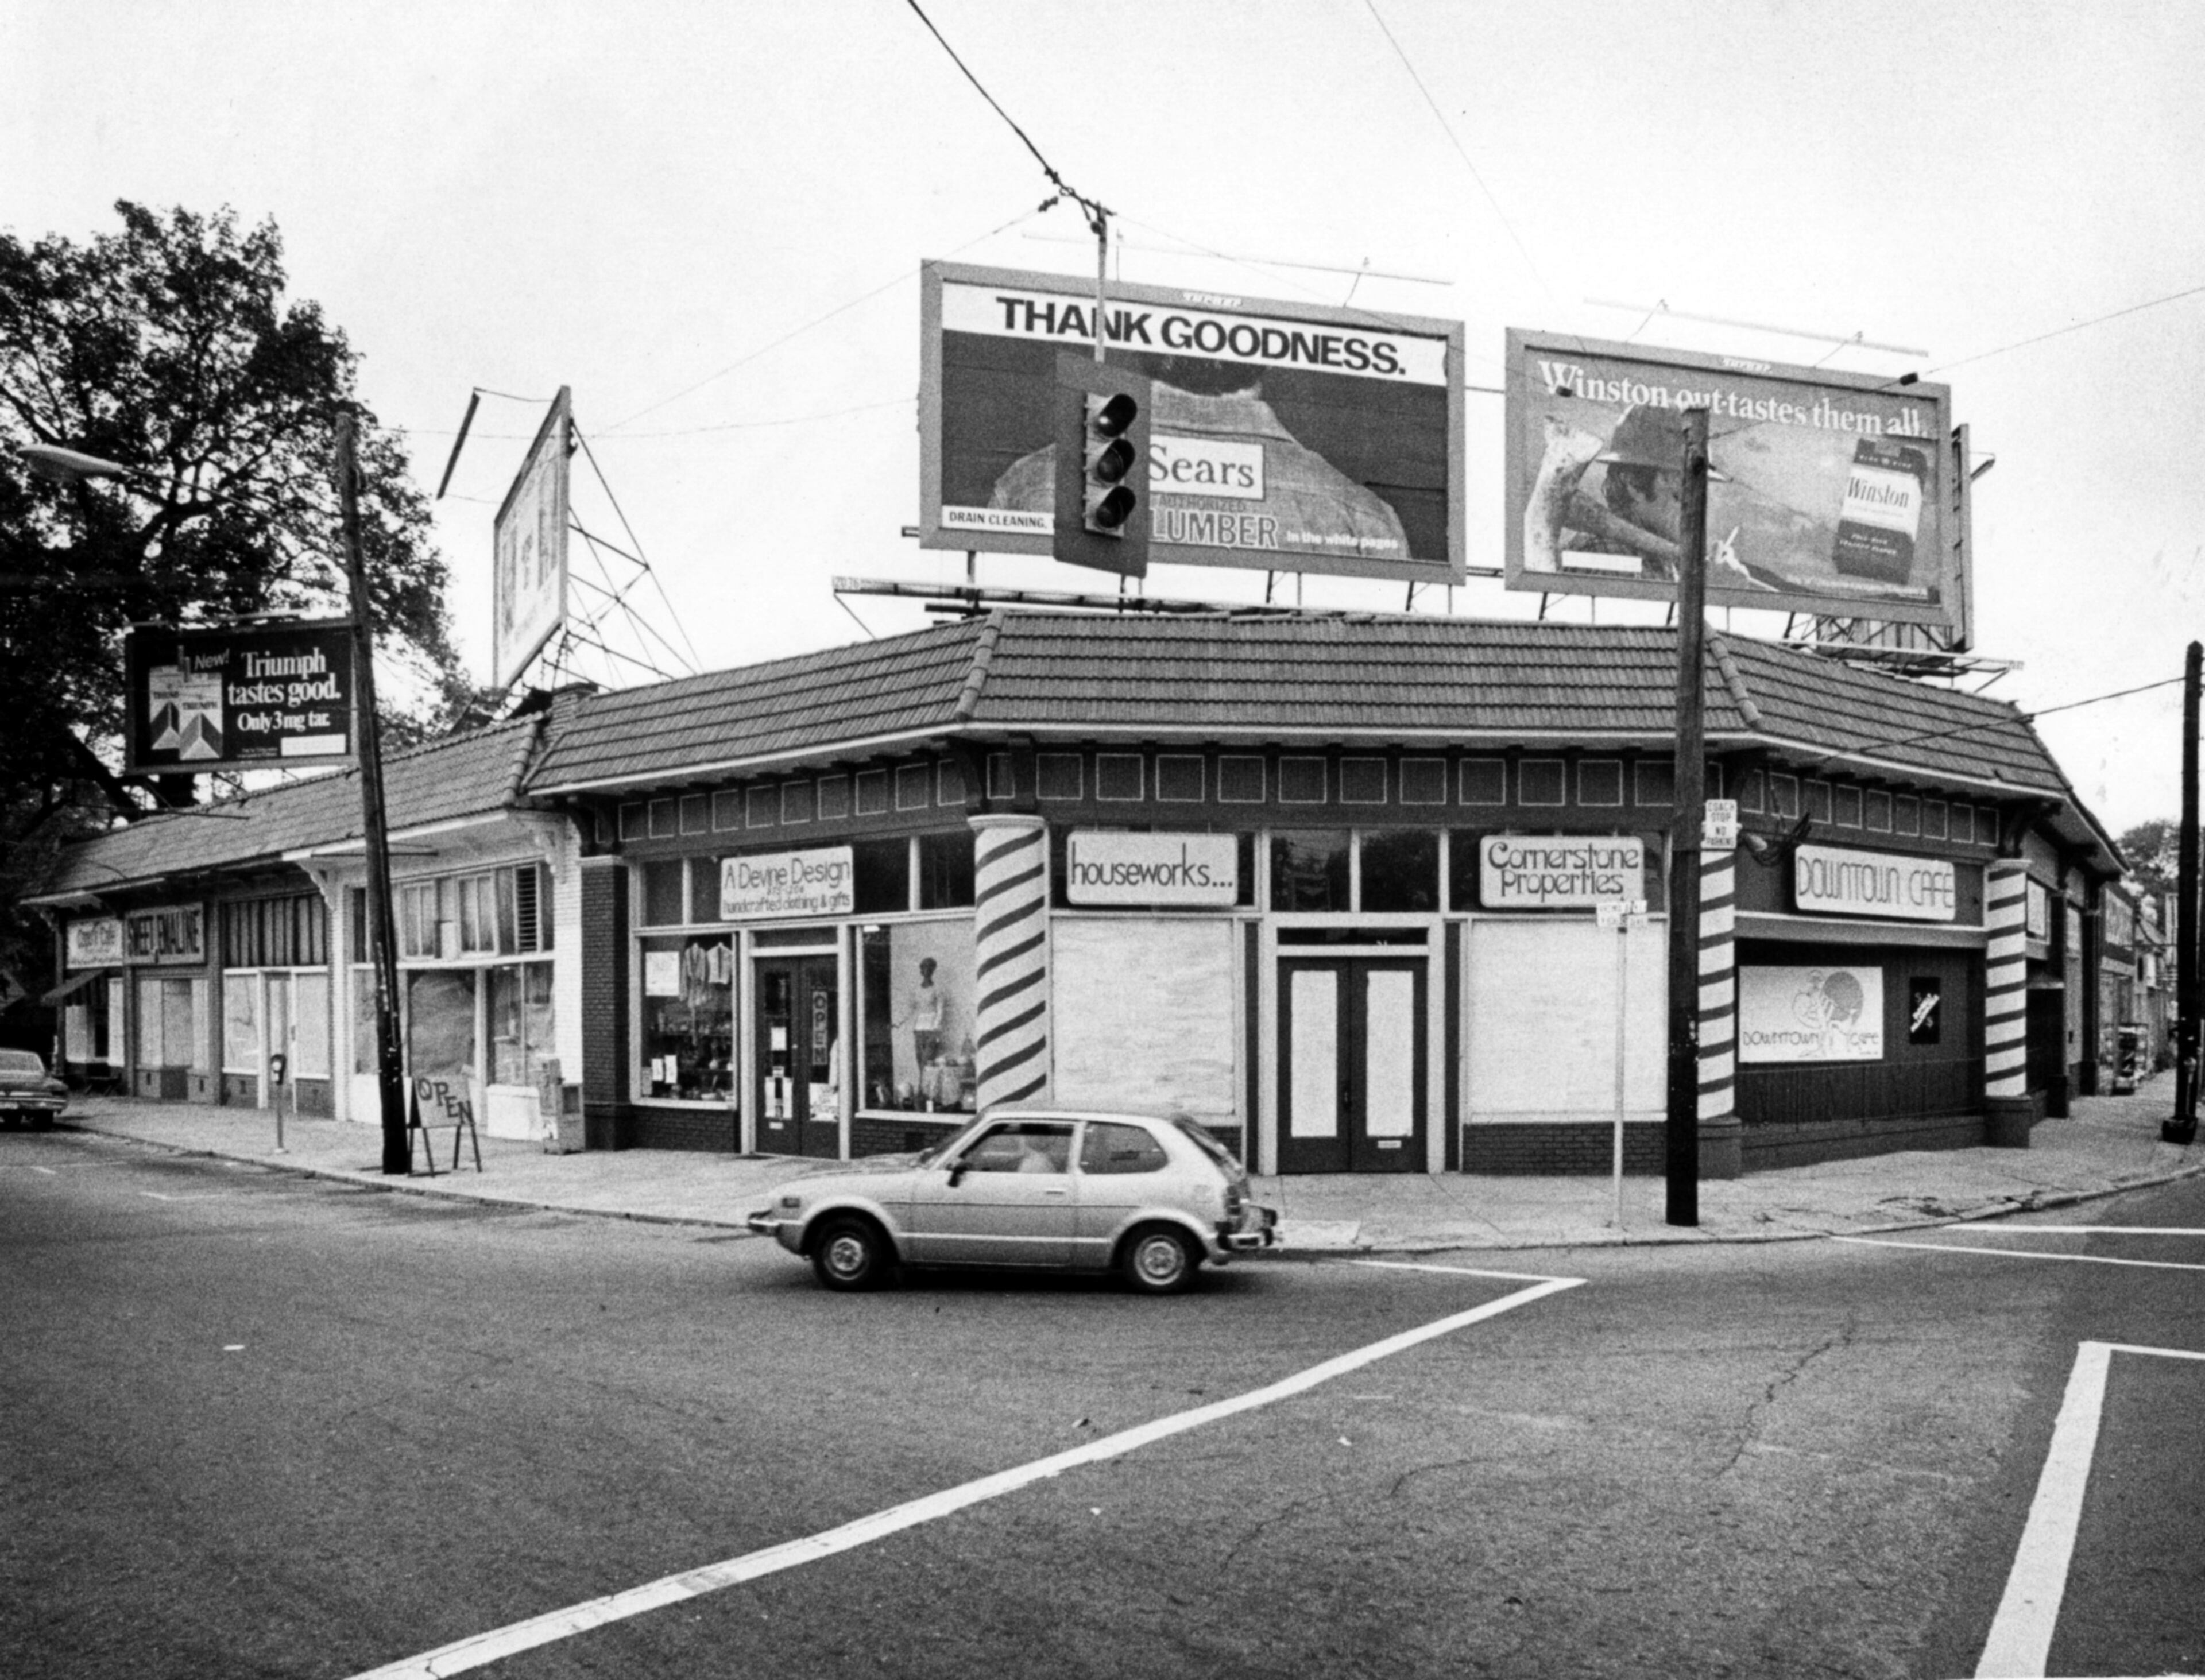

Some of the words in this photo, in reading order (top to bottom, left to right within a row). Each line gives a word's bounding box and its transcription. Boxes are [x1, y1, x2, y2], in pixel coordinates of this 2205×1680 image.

[996, 297, 1152, 345] THANK
[1160, 316, 1406, 375] GOODNESS.
[1537, 360, 1669, 408] Winston
[1812, 397, 1882, 435] them
[1148, 444, 1255, 488] Sears
[1158, 494, 1247, 513] AUTHORIZED
[1847, 476, 1910, 508] Winston
[949, 510, 985, 524] DRAIN
[1149, 509, 1278, 549] LUMBER
[1302, 530, 1322, 544] the
[1325, 533, 1359, 546] white
[1360, 537, 1398, 550] pages
[195, 648, 230, 671] New!
[241, 647, 326, 680] Triumph
[228, 680, 285, 705] tastes
[288, 673, 342, 708] good.
[237, 711, 273, 734] Only
[1711, 812, 1731, 822] STOP
[1070, 841, 1233, 887] houseworks...
[1488, 841, 1639, 870] Cornerstone
[725, 864, 737, 889] A
[791, 857, 850, 889] Design
[1500, 868, 1624, 903] Properties
[1909, 869, 1953, 908] CAFE
[723, 897, 782, 913] handcrafted
[783, 896, 818, 913] clothing
[820, 894, 827, 908] &
[829, 891, 850, 911] gifts
[417, 1078, 476, 1126] OPEN
